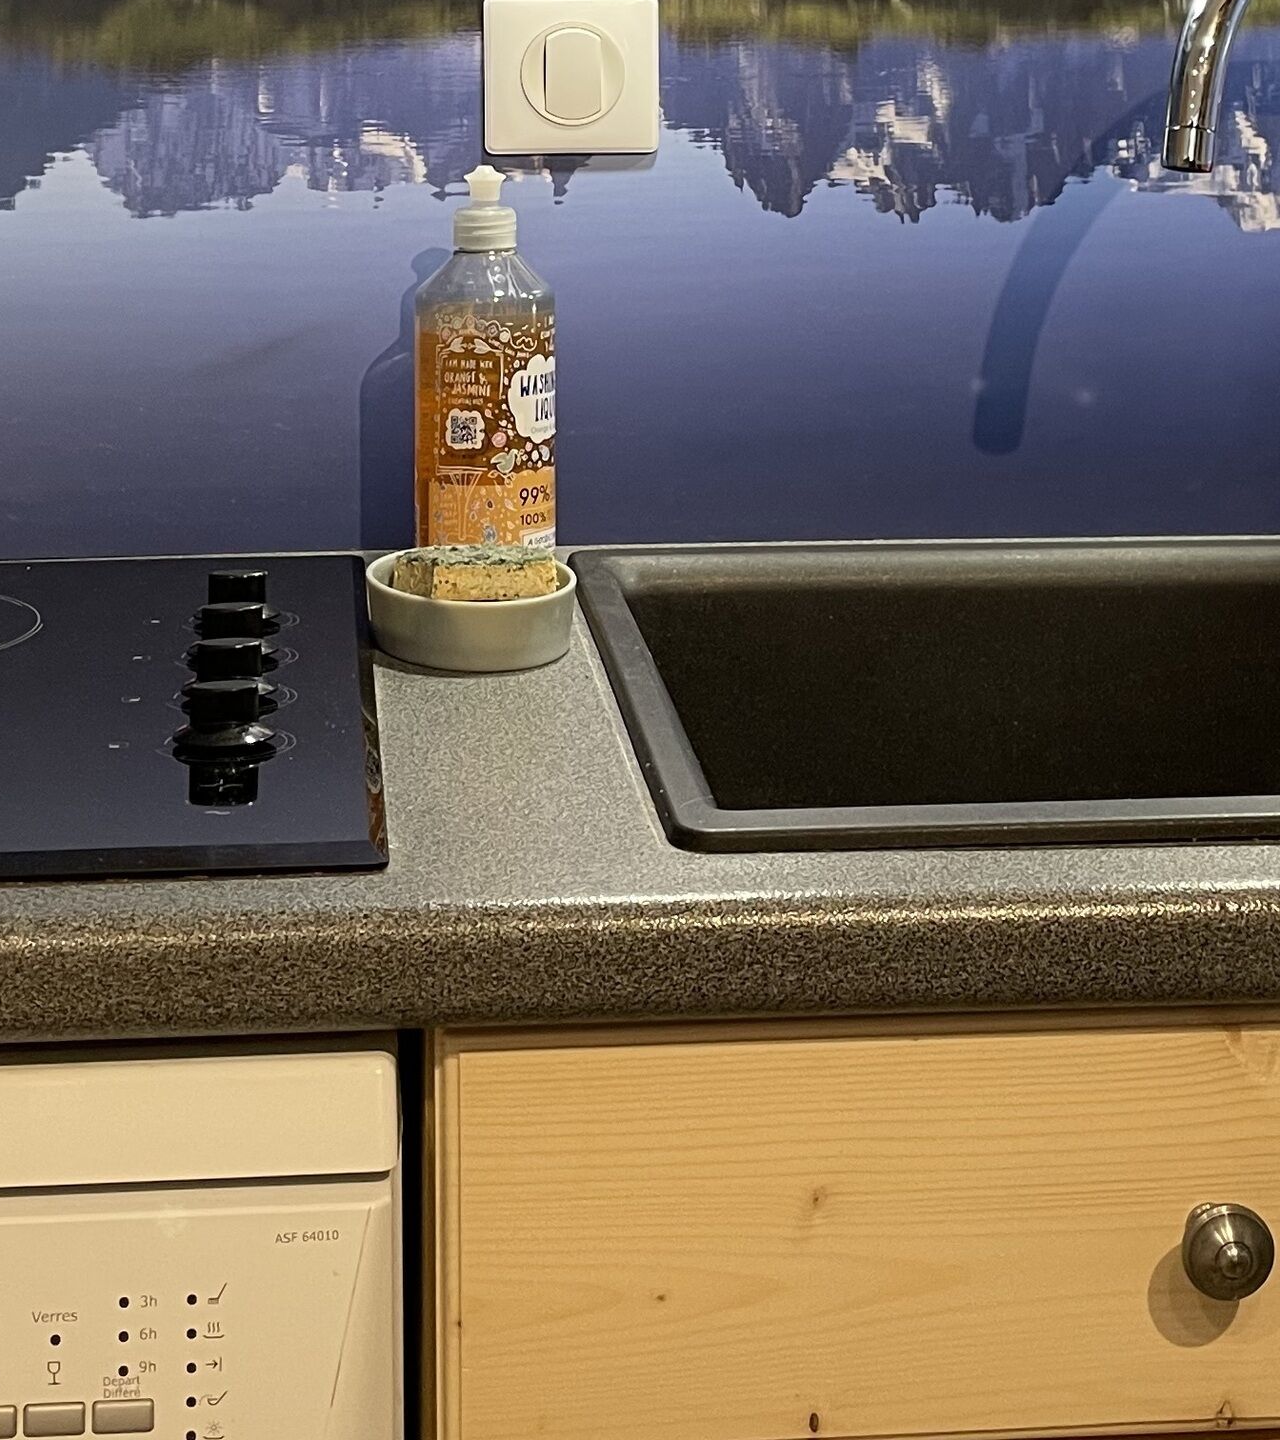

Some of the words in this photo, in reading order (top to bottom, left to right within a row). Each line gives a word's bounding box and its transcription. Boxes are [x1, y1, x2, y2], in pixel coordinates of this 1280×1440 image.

[443, 371, 477, 384] ORANGE
[451, 383, 492, 397] JASMINE
[519, 484, 551, 507] 99%
[519, 511, 547, 526] 100%
[275, 1231, 298, 1244] ASF
[302, 1229, 340, 1242] 64010
[140, 1294, 158, 1308] 3h
[32, 1311, 78, 1324] Verres
[139, 1328, 157, 1340] 6h
[138, 1361, 157, 1373] 9h
